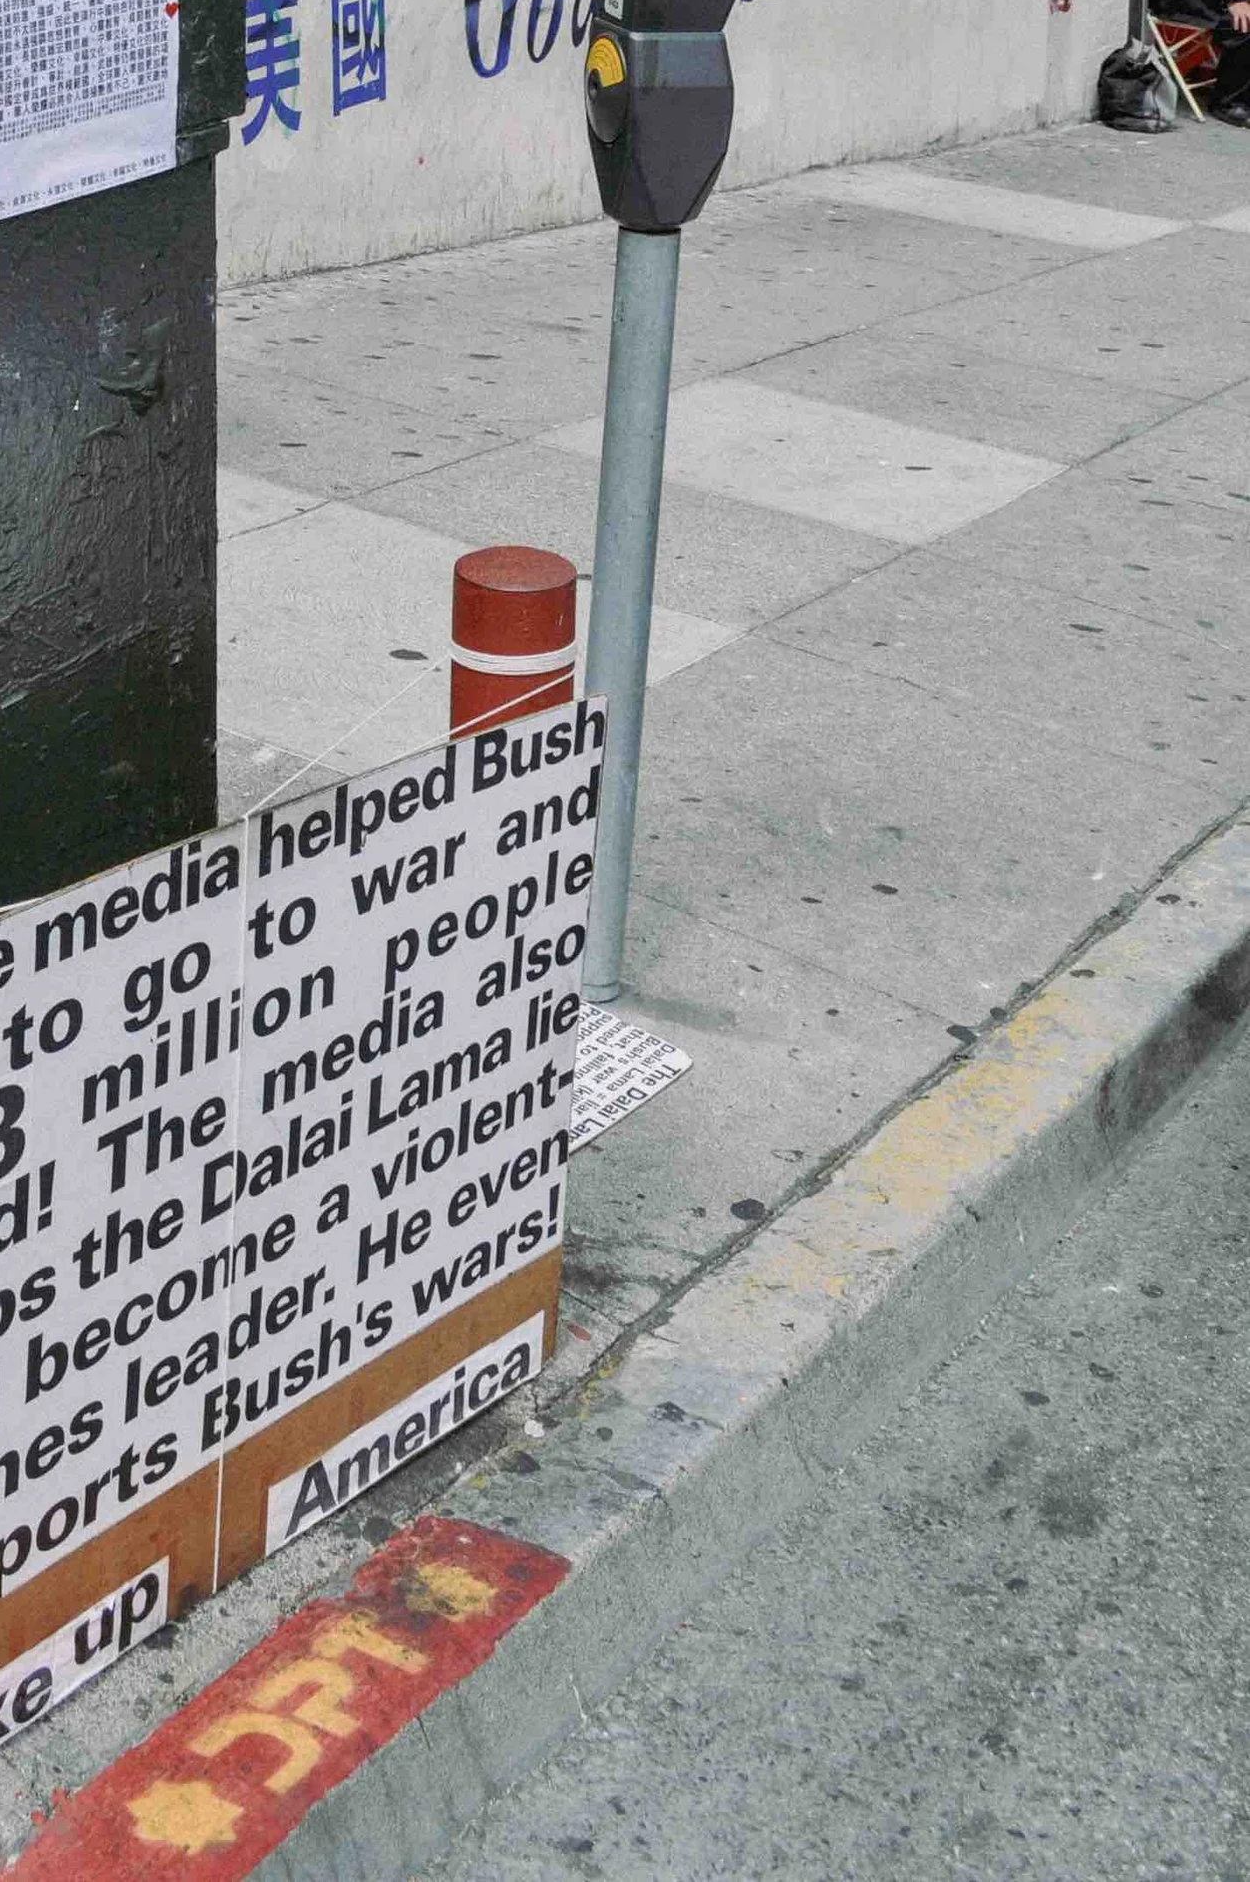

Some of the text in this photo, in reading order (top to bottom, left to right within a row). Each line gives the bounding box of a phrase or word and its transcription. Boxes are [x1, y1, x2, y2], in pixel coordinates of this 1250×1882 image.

[1, 997, 83, 1071] to
[122, 941, 211, 1033] go
[247, 896, 316, 959] to
[350, 830, 466, 915] war
[495, 752, 605, 856] and
[33, 844, 240, 972] media
[257, 743, 457, 878] helped
[471, 698, 607, 794] Bush
[81, 964, 335, 1124] million
[383, 849, 594, 995] people
[96, 1095, 226, 1193] The
[261, 986, 444, 1115] media
[474, 923, 586, 1007] also
[24, 1213, 296, 1404] become
[315, 1183, 350, 1234] a
[370, 1059, 575, 1200] violent-
[71, 1197, 184, 1290] the
[200, 1088, 354, 1225] Dalai
[366, 1026, 512, 1136] Lama
[525, 988, 580, 1052] lie
[123, 1265, 335, 1424] leader.
[355, 1208, 431, 1285] He
[446, 1128, 570, 1228] even
[200, 1299, 393, 1452] Bush's
[411, 1182, 560, 1316] wars!
[73, 1570, 160, 1667] up
[284, 1336, 532, 1539] America
